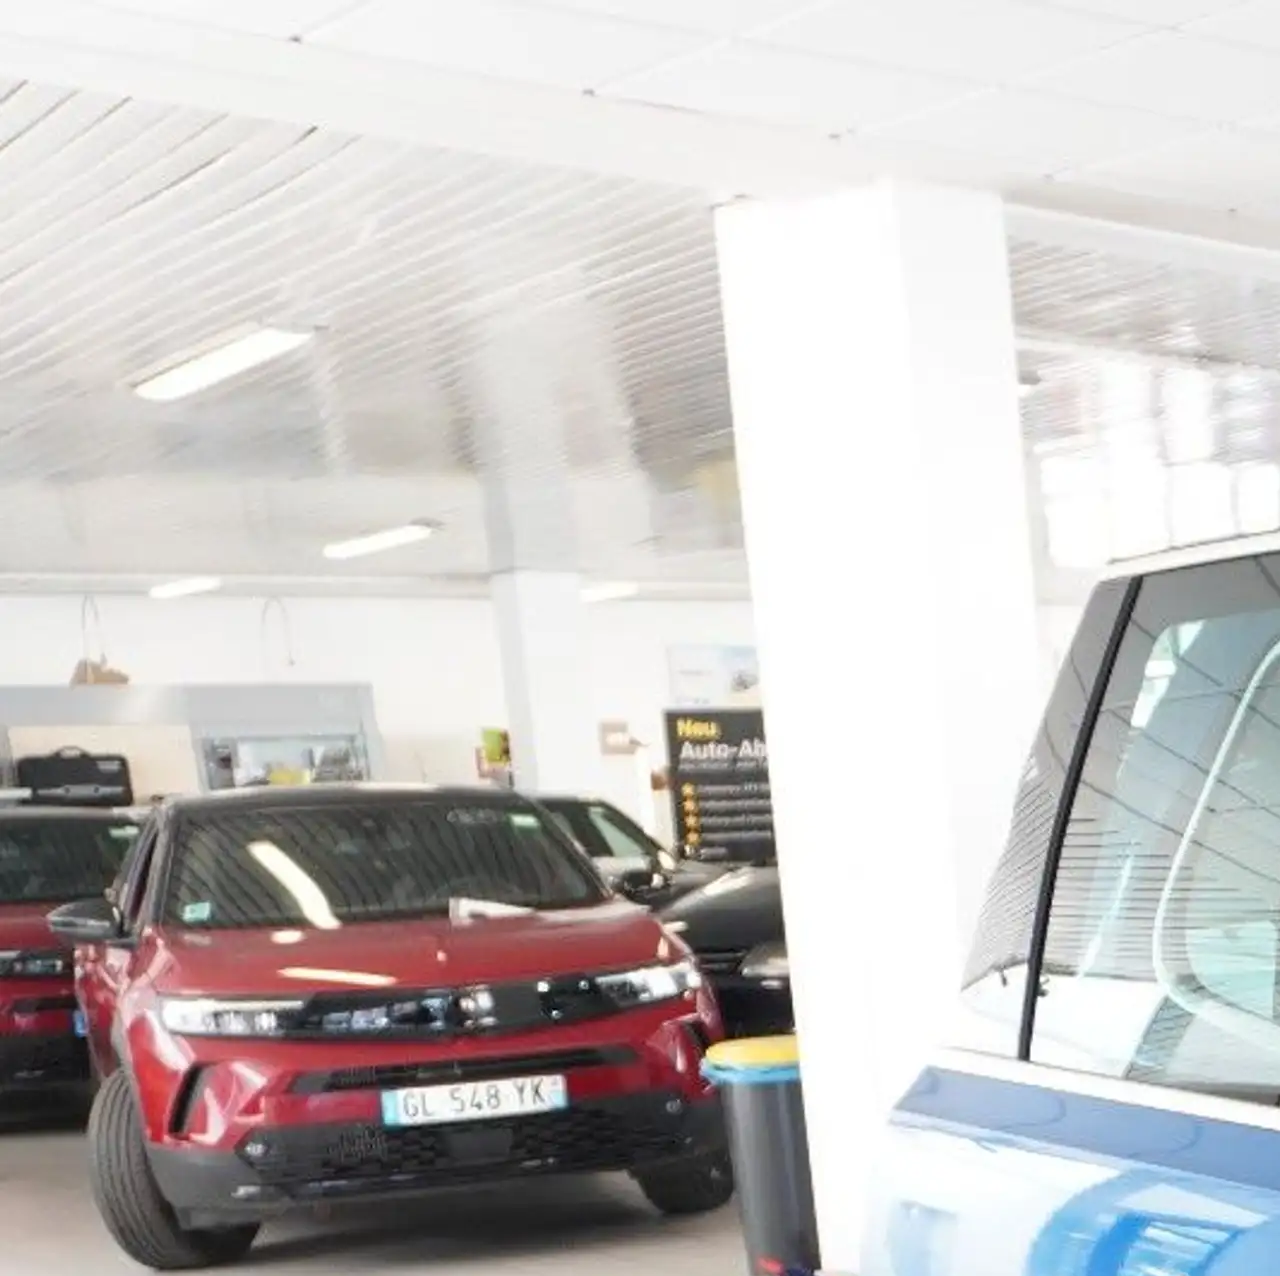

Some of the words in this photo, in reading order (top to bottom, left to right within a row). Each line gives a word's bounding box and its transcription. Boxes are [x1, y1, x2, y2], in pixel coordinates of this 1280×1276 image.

[402, 1090, 434, 1117] GL
[449, 1084, 501, 1112] 548
[512, 1077, 546, 1105] YK
